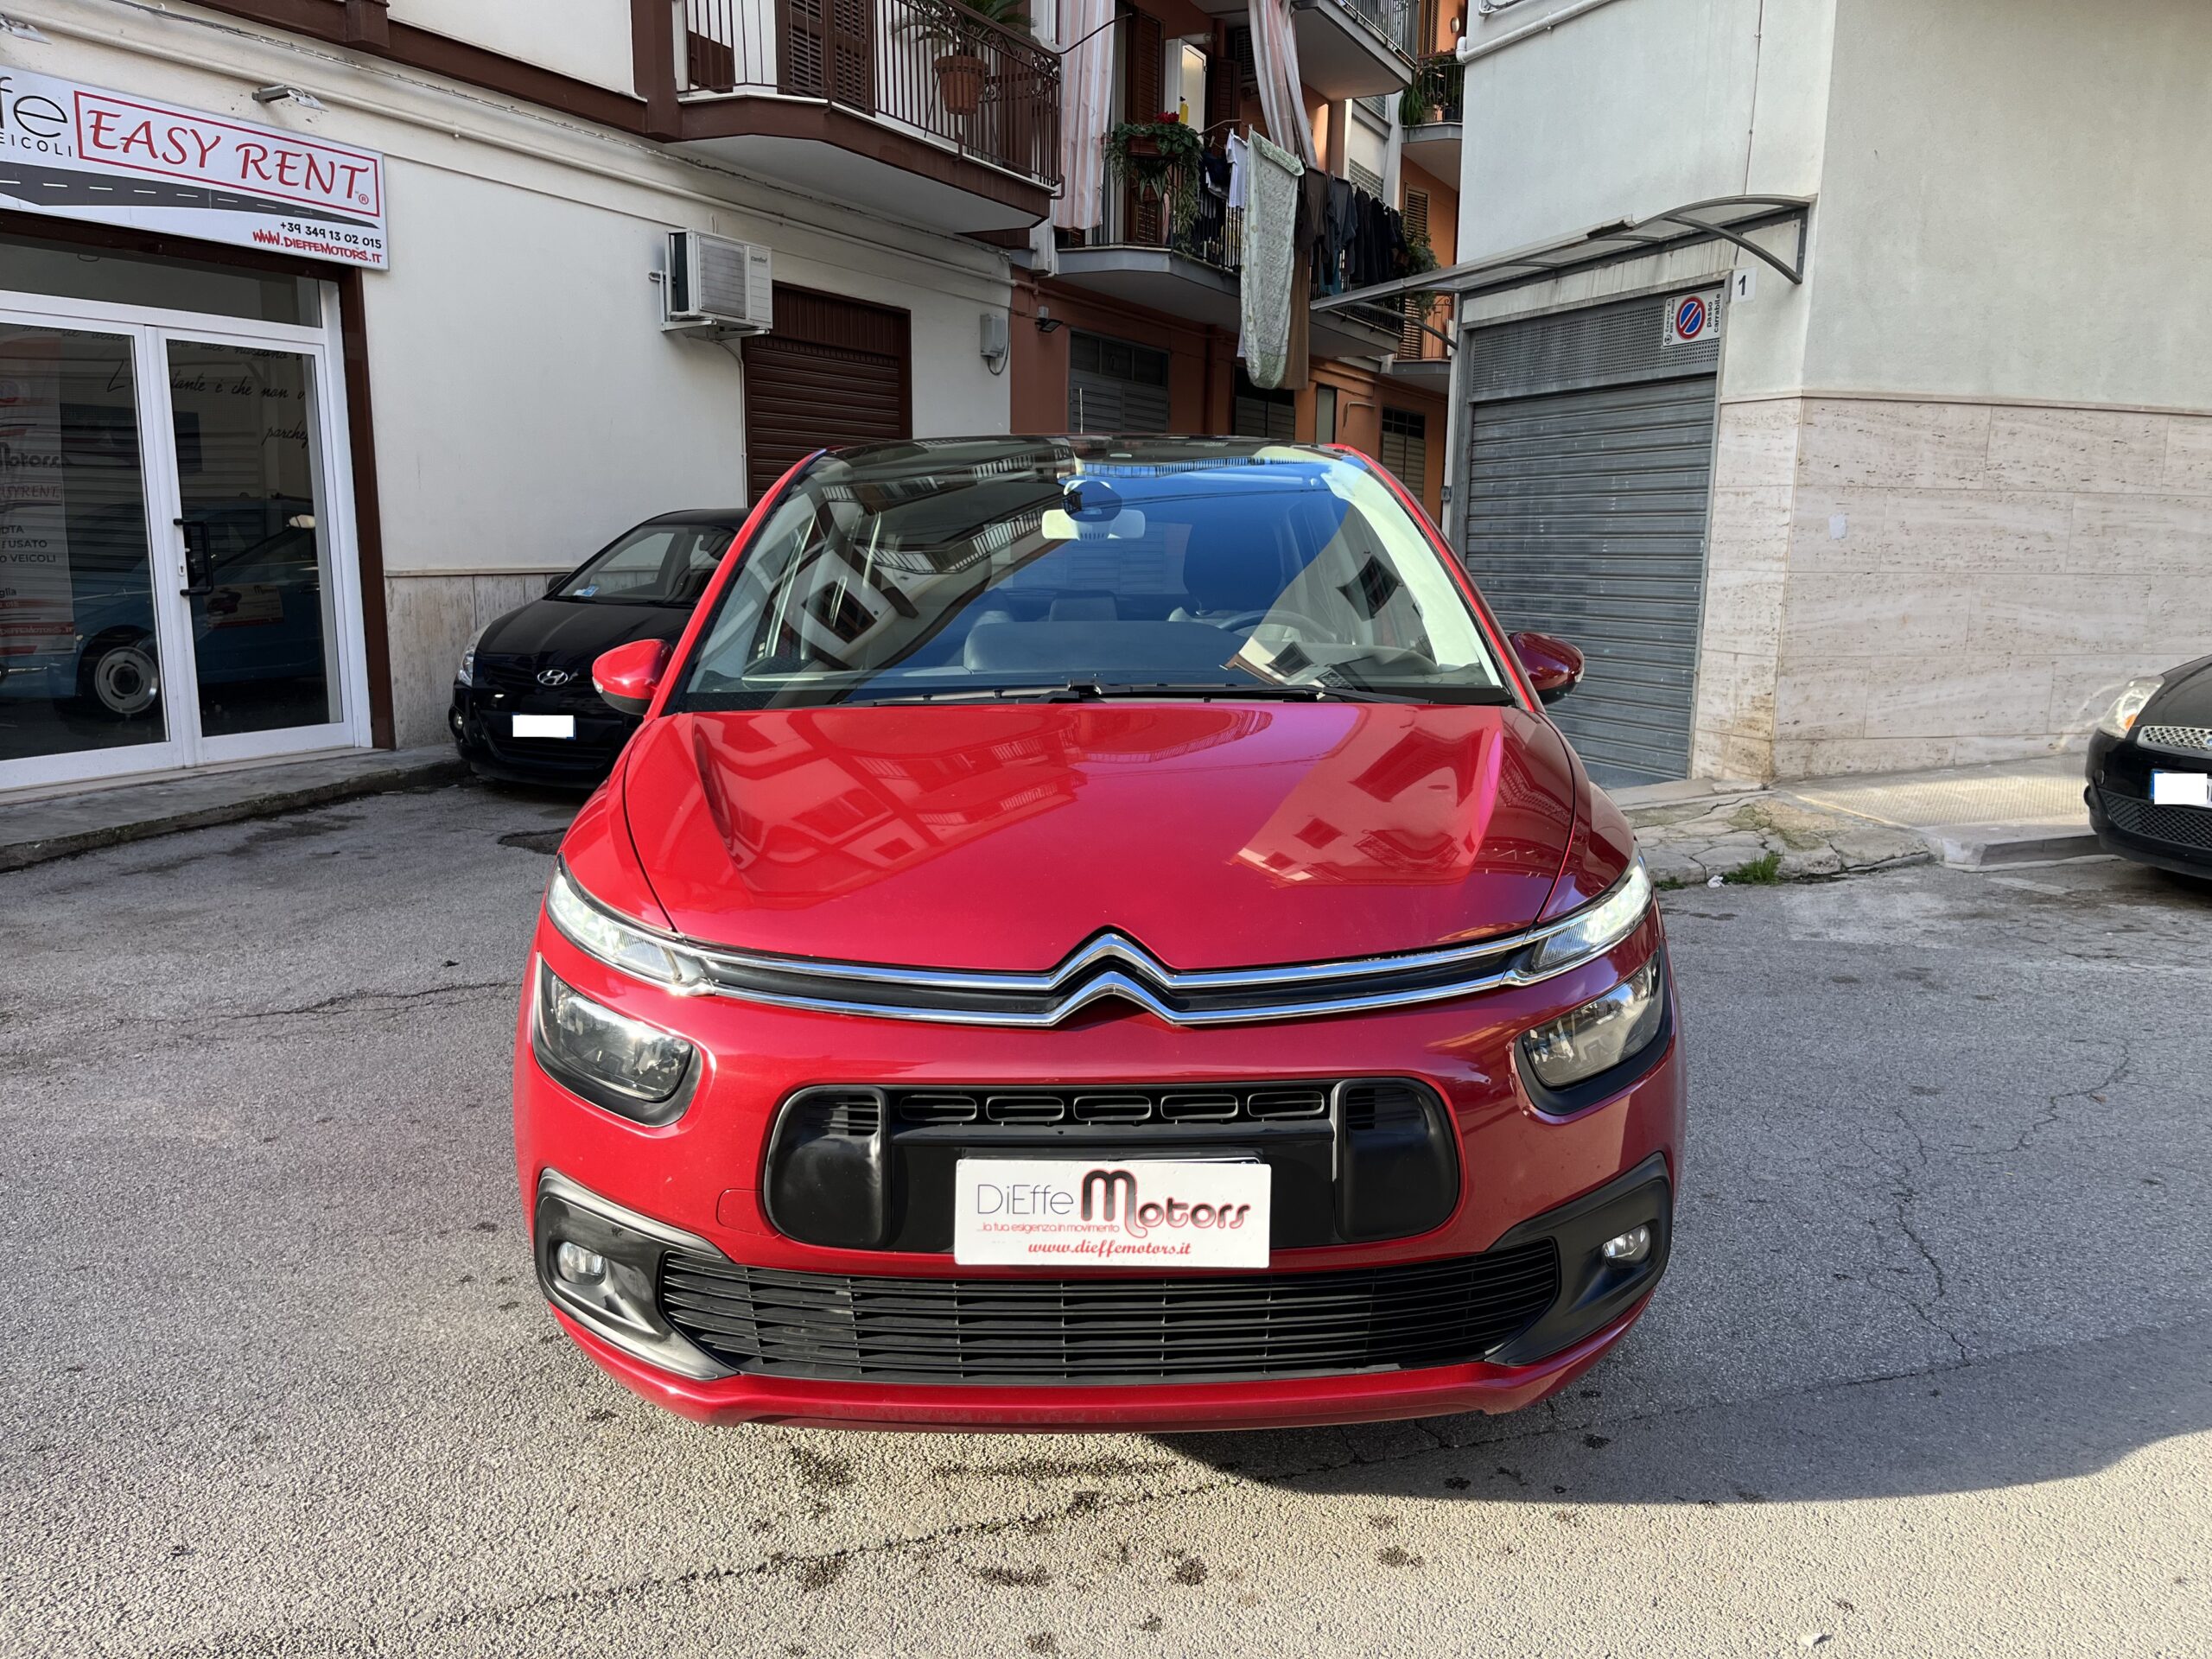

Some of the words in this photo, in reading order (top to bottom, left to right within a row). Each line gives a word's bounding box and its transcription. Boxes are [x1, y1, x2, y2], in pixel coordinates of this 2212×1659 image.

[87, 110, 221, 168] EASY
[235, 143, 370, 199] RENT
[280, 221, 302, 234] +39
[305, 226, 327, 238] 349
[329, 230, 341, 241] 13
[344, 233, 359, 245] 02
[362, 237, 382, 249] 015
[1738, 275, 1746, 296] 1
[231, 375, 253, 397] che
[261, 387, 289, 400] non
[8, 539, 48, 548] USATO
[10, 554, 56, 563] VEICOLI
[977, 1184, 1074, 1215] DiEffe
[1081, 1169, 1252, 1239] Motors
[994, 1223, 1010, 1232] tua
[1011, 1224, 1057, 1235] esigenza
[1067, 1224, 1121, 1233] movimento
[1027, 1239, 1192, 1258] www.dieffemotors.it
